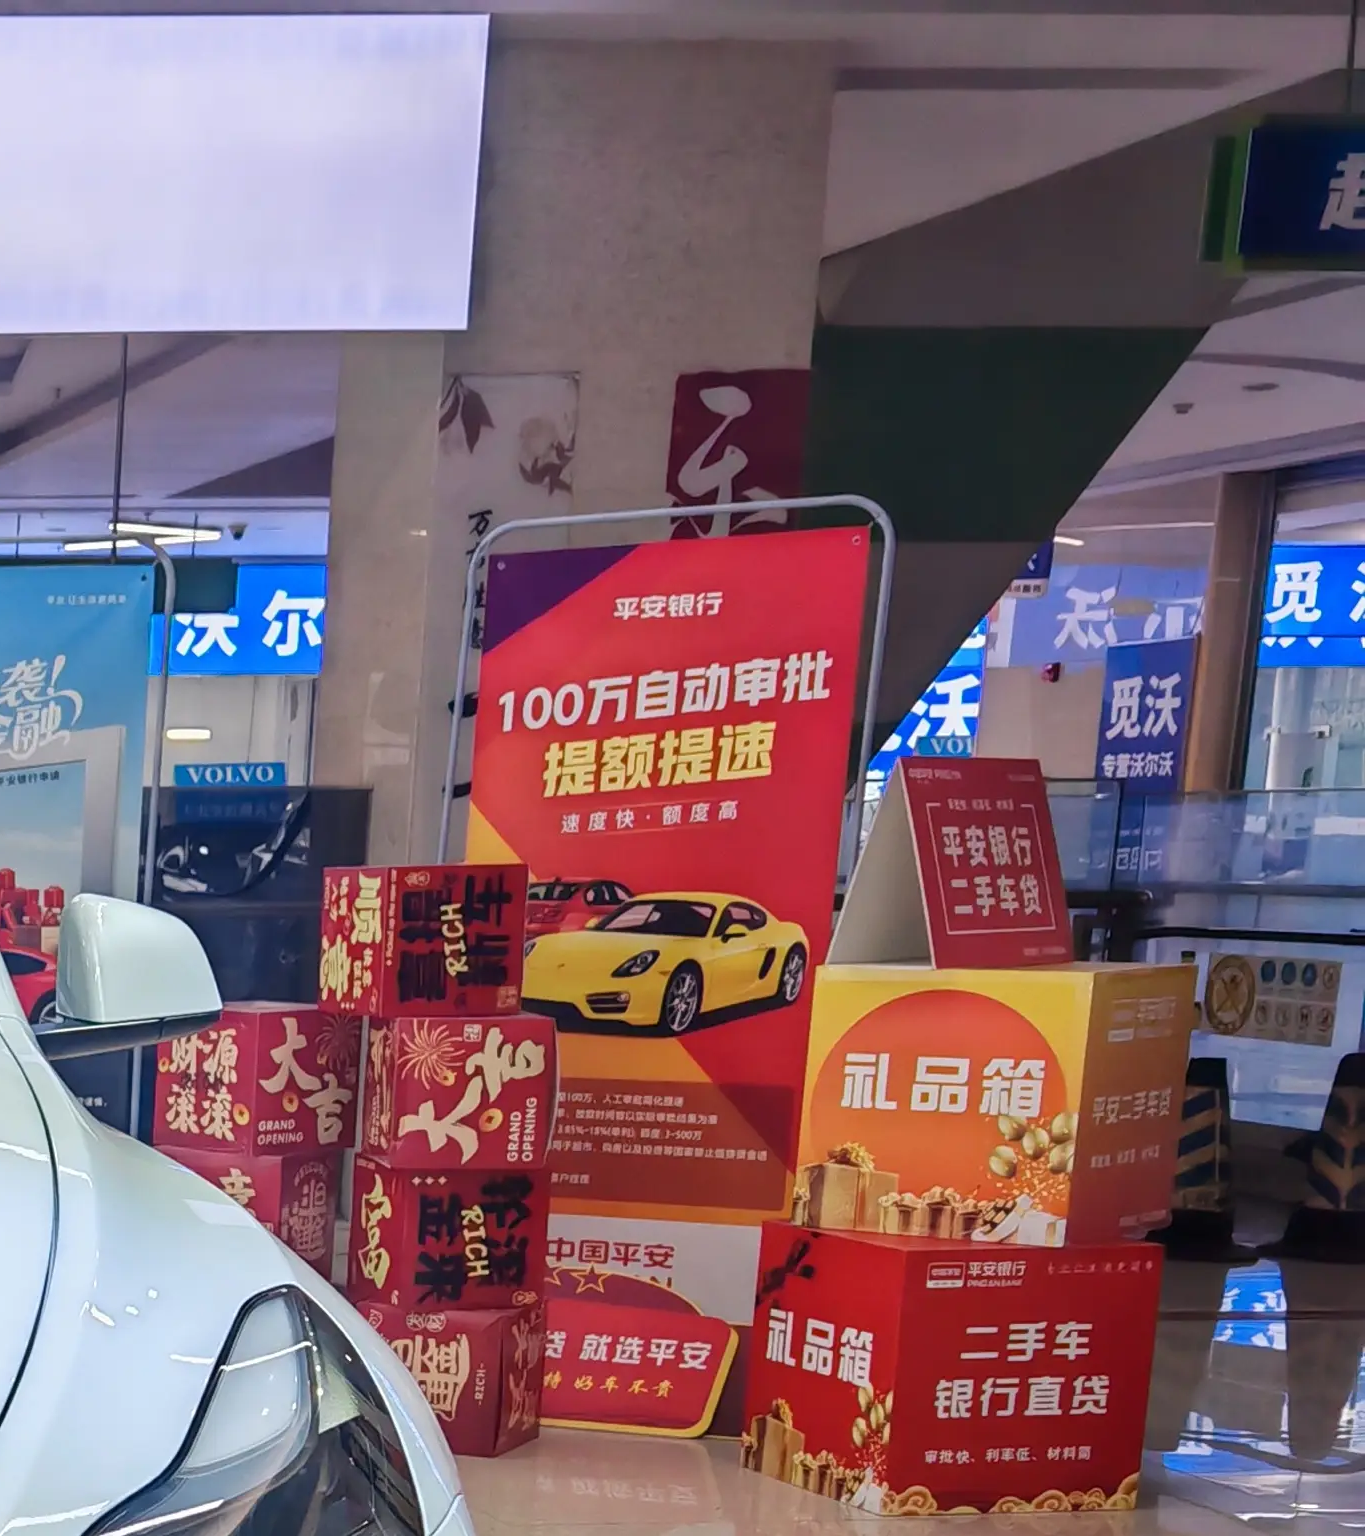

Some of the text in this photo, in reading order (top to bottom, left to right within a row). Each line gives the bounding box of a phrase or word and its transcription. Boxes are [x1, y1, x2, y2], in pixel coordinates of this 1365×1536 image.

[613, 591, 724, 621] 平安银行
[1265, 560, 1365, 624] 觅
[498, 650, 834, 733] 100万自动审批
[1105, 672, 1182, 741] 觅沃
[543, 721, 777, 798] 提额提速
[930, 738, 974, 755] VO
[1101, 750, 1174, 780] 专营沃尔沃
[186, 765, 275, 784] VOLVO
[941, 825, 1032, 868] 平安银行
[950, 873, 1042, 917] 二手车贷
[438, 903, 470, 978] RICH
[840, 1052, 1046, 1119] 礼品箱
[257, 1131, 304, 1146] OPENING
[258, 1118, 296, 1131] GRAND
[506, 1110, 522, 1162] GRAND
[521, 1096, 538, 1162] OPENING
[358, 1173, 393, 1290] 富
[460, 1203, 490, 1279] RICH
[547, 1236, 675, 1270] 中国平安
[967, 1260, 1027, 1278] 平安银行
[579, 1332, 713, 1371] 就选平安
[765, 1308, 875, 1389] 礼品箱
[960, 1321, 1093, 1363] 二手车
[934, 1374, 1111, 1420] 银行直贷
